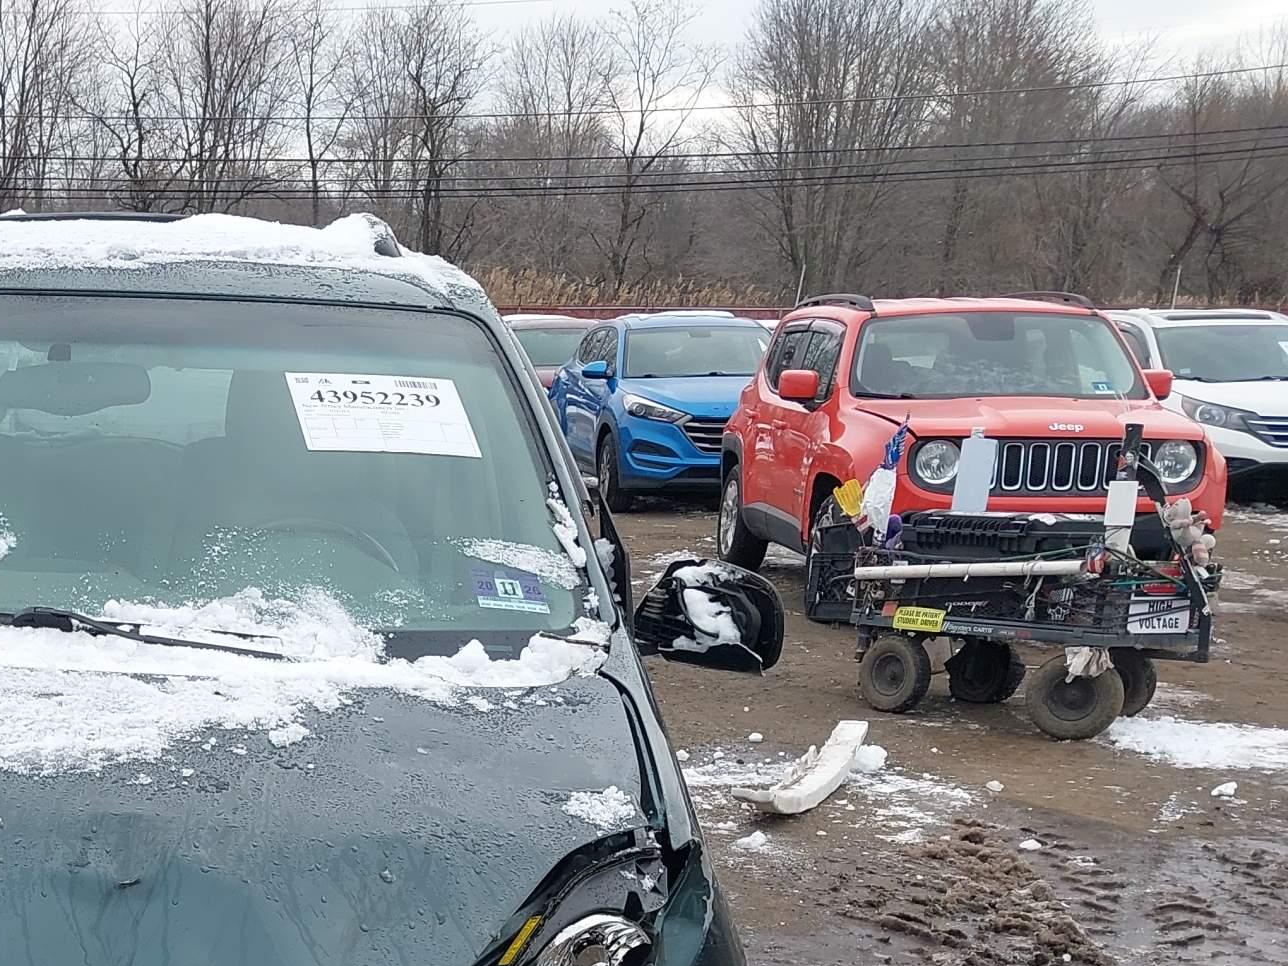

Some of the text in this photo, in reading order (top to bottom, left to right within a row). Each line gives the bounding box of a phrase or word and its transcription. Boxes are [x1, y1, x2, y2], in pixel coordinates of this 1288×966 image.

[310, 389, 441, 408] 43952239
[1048, 422, 1084, 433] Jeep
[477, 581, 494, 591] 20
[499, 581, 519, 596] 11
[1148, 600, 1173, 612] HIGH
[898, 608, 914, 617] PLEASE
[922, 610, 942, 618] PATIENT
[896, 616, 939, 627] STUDENT DRIVER
[1138, 617, 1180, 629] VOLTAGE
